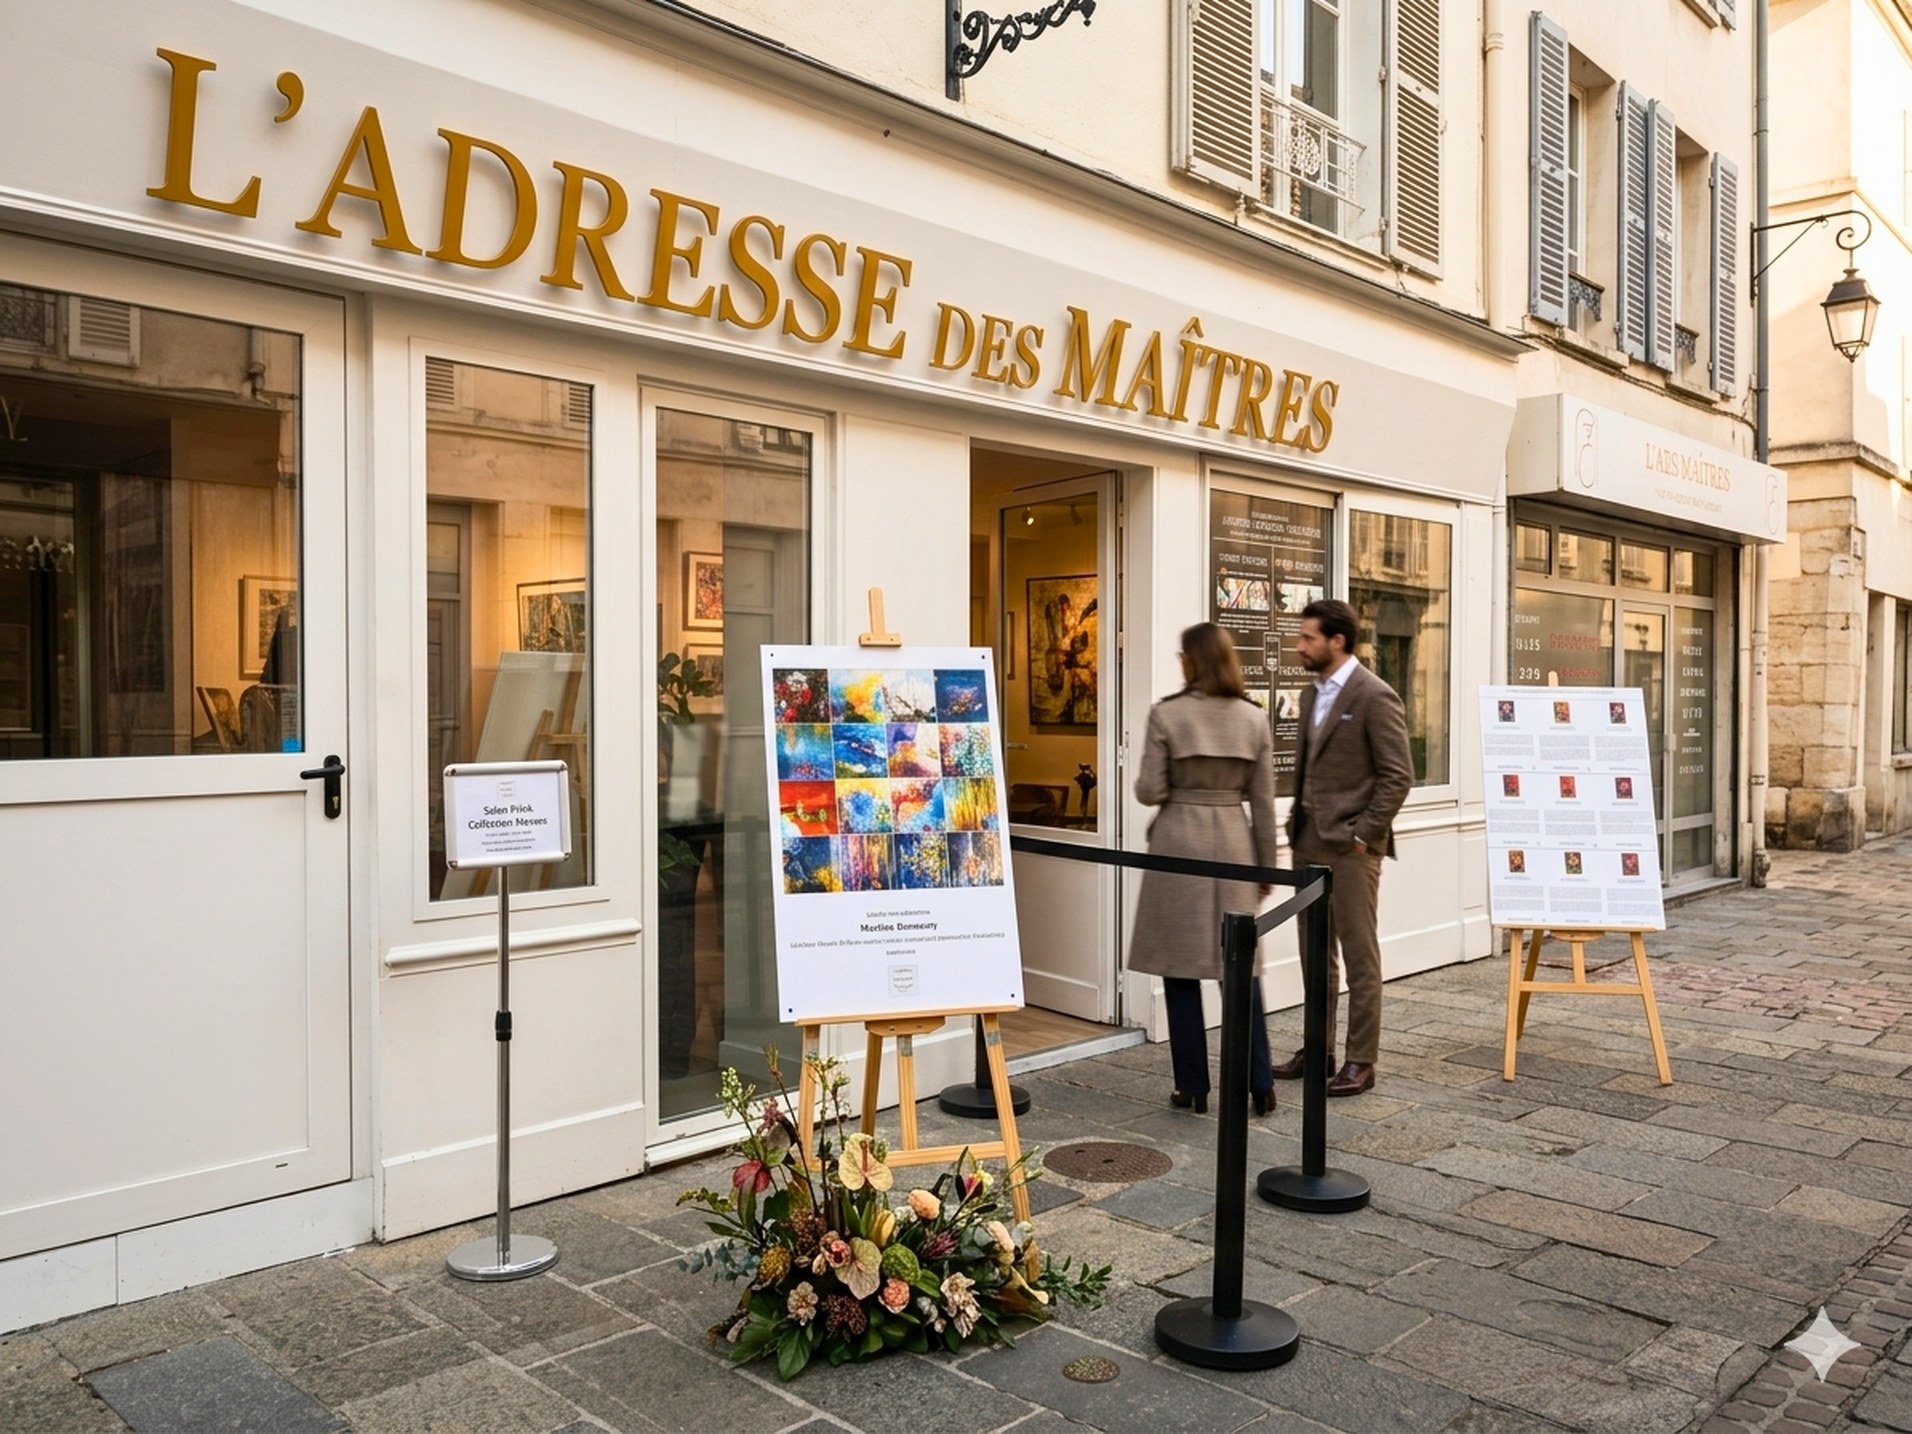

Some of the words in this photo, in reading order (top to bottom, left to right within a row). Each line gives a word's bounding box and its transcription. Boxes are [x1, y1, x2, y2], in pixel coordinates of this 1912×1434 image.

[146, 47, 913, 360] L'ADRESSE
[929, 302, 1044, 389] DES
[1053, 305, 1340, 453] MAÎTRES
